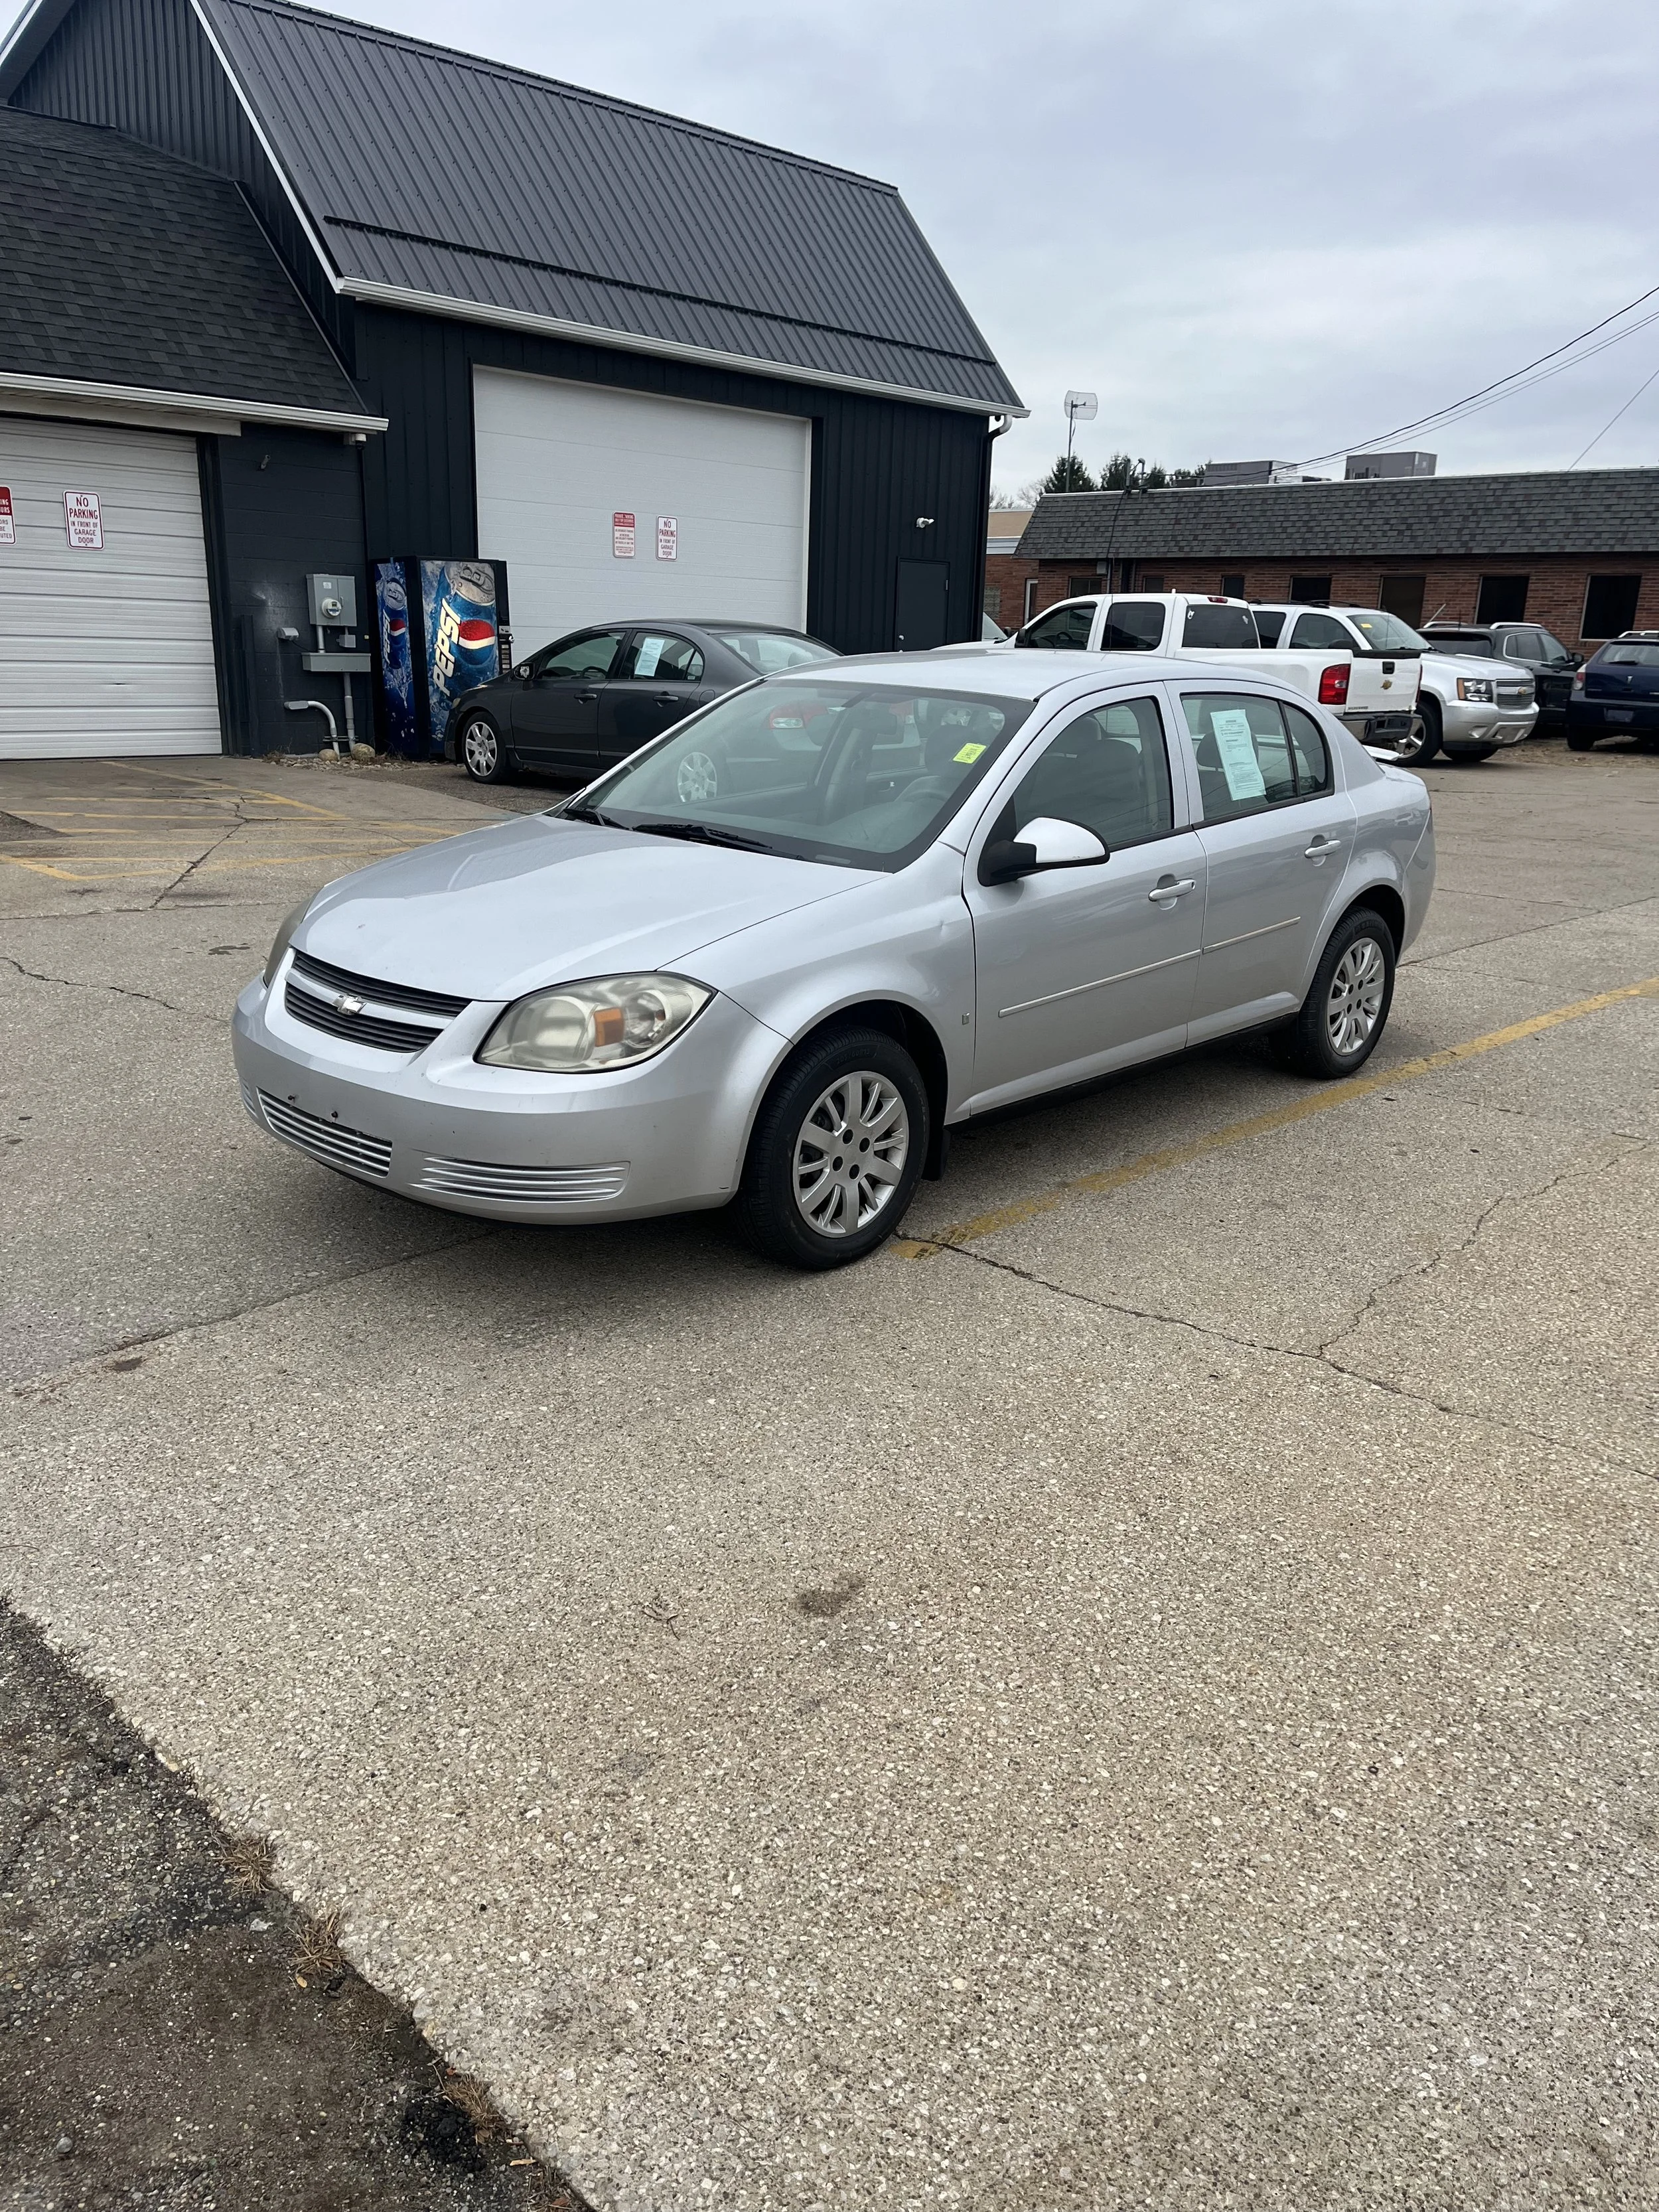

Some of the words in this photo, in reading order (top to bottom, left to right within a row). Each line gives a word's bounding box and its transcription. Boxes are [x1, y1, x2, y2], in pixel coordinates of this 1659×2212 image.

[76, 497, 89, 507] NO
[69, 508, 98, 520] PARKING
[664, 520, 672, 528] NO
[659, 529, 676, 538] PARKING
[382, 609, 391, 664] PEPSI
[433, 598, 462, 696] PEPSI
